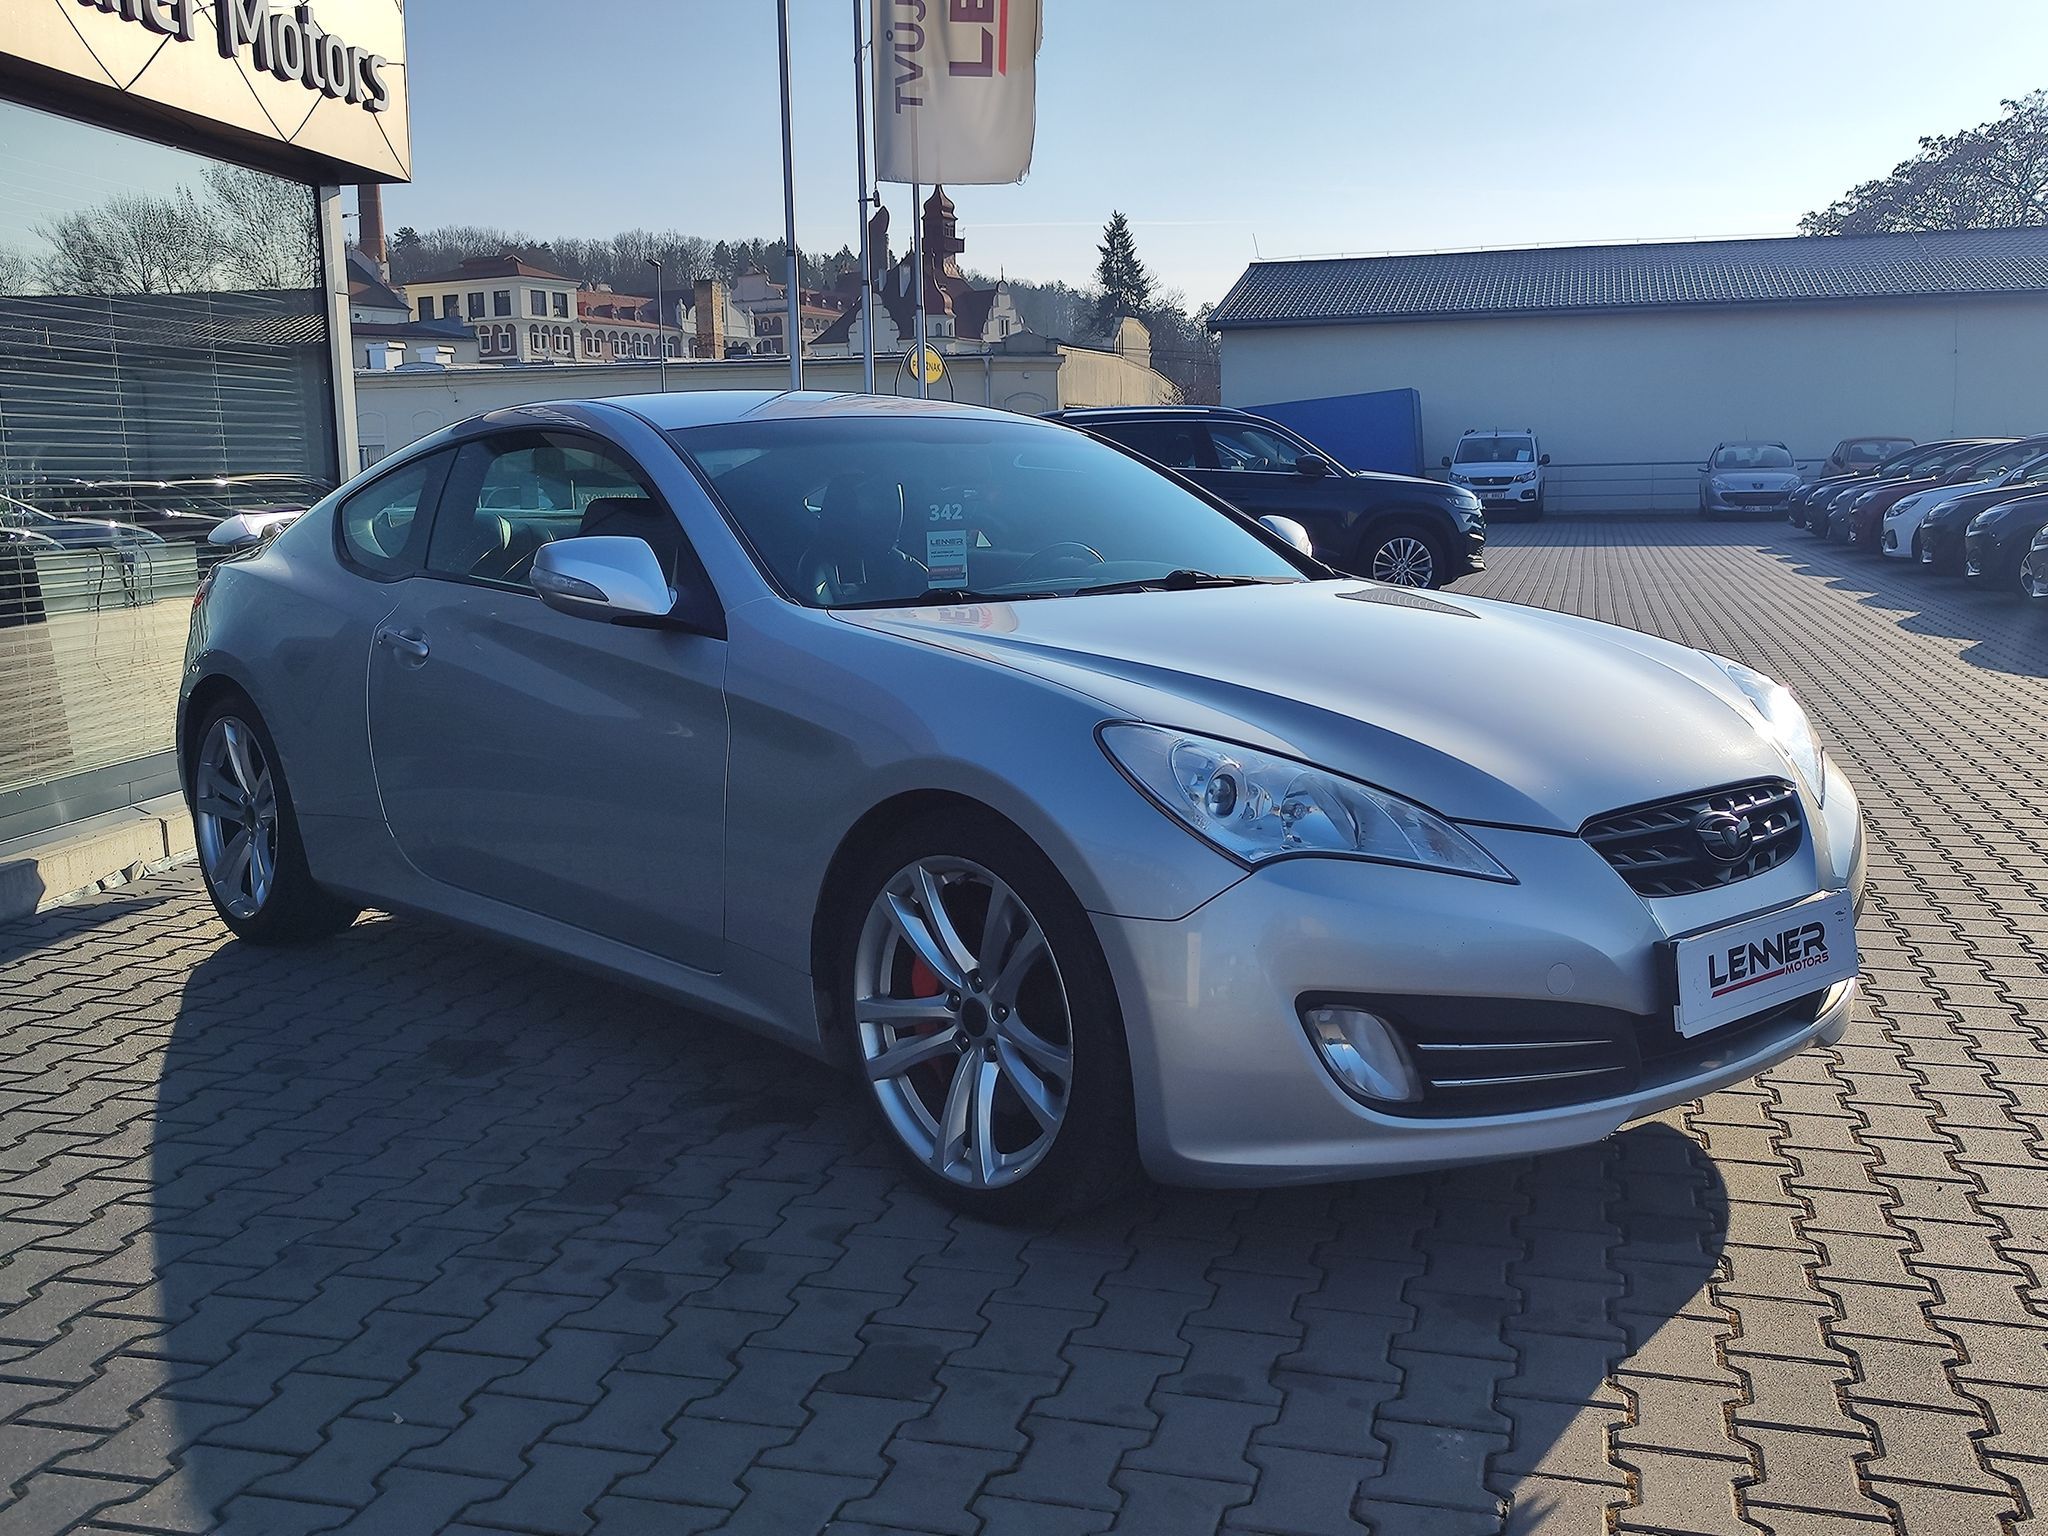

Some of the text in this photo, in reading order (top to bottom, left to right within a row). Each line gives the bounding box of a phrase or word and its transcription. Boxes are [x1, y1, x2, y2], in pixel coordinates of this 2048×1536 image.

[214, 0, 390, 112] Motors
[886, 0, 926, 114] TVŮJ
[929, 503, 963, 521] 342
[1708, 921, 1828, 989] LENNER
[1785, 952, 1829, 975] MOTORS
